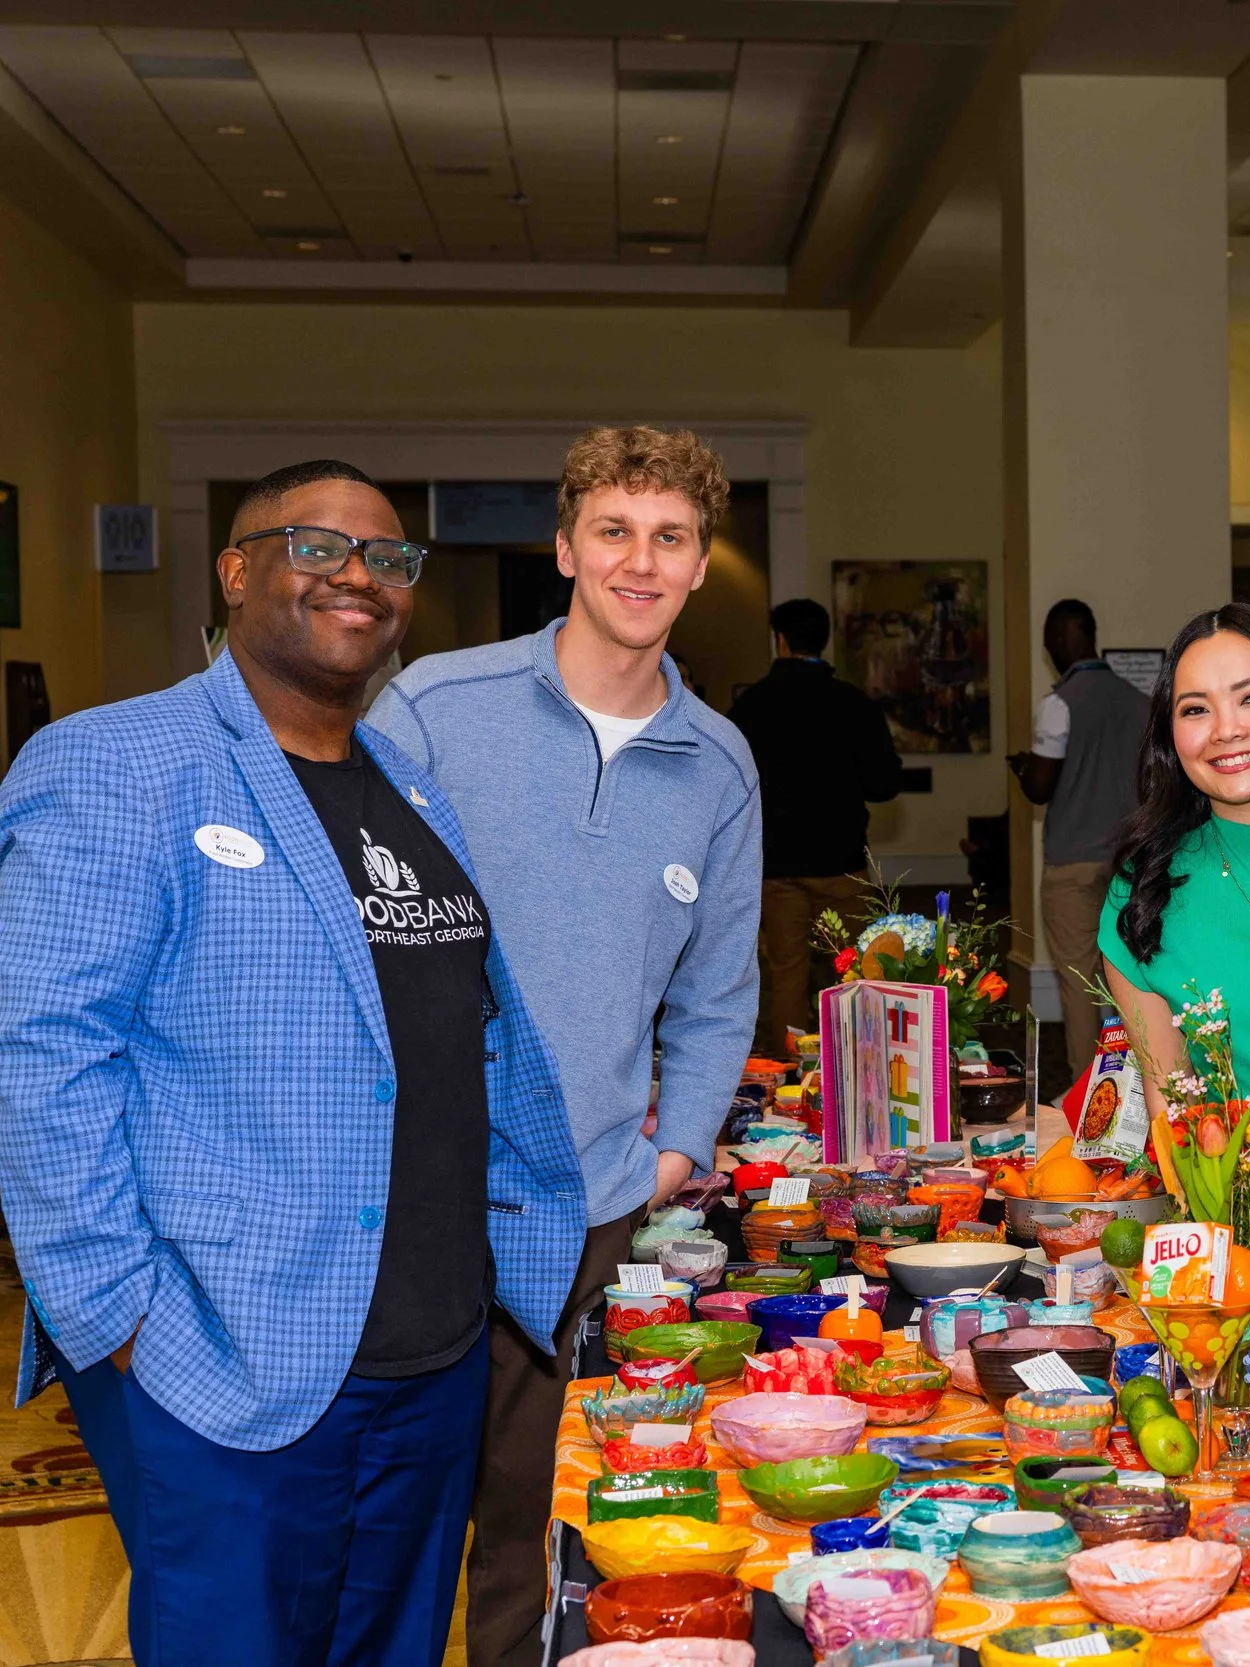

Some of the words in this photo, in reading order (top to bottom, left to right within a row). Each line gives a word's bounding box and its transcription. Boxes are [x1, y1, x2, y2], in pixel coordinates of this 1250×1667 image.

[215, 844, 232, 854] Kyle
[233, 849, 246, 858] Fox
[353, 895, 483, 928] ODBANK
[364, 929, 431, 945] ORTHEAST
[434, 926, 485, 942] GEORGIA
